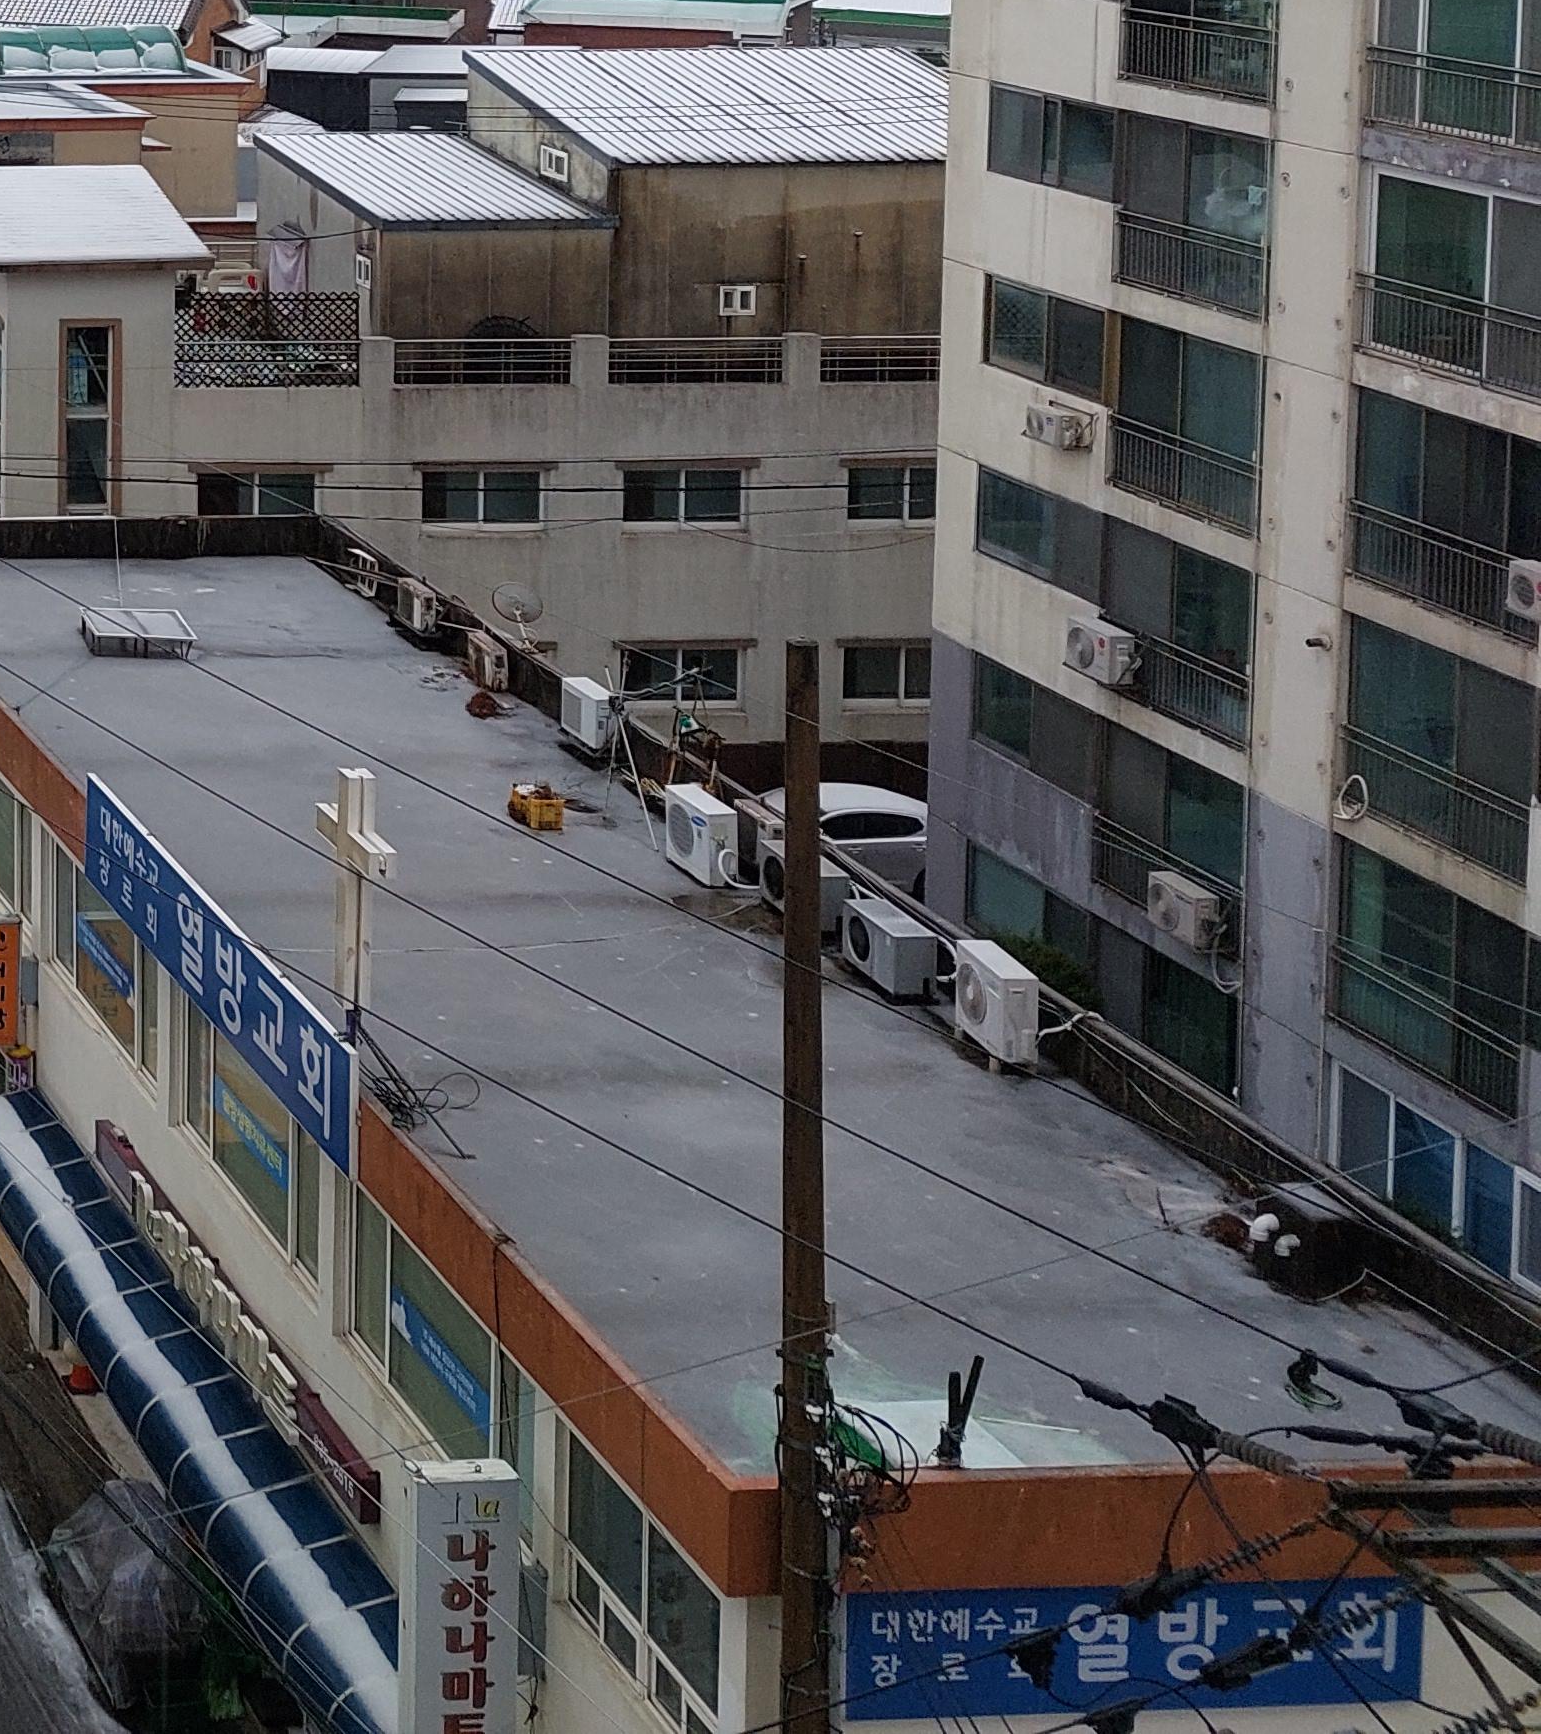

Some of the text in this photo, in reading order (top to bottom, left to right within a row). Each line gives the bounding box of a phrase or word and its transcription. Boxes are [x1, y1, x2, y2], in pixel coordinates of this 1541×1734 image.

[100, 804, 160, 894] 대한예수교
[176, 891, 332, 1142] 열방교회
[871, 1607, 1039, 1643] 대한예수교
